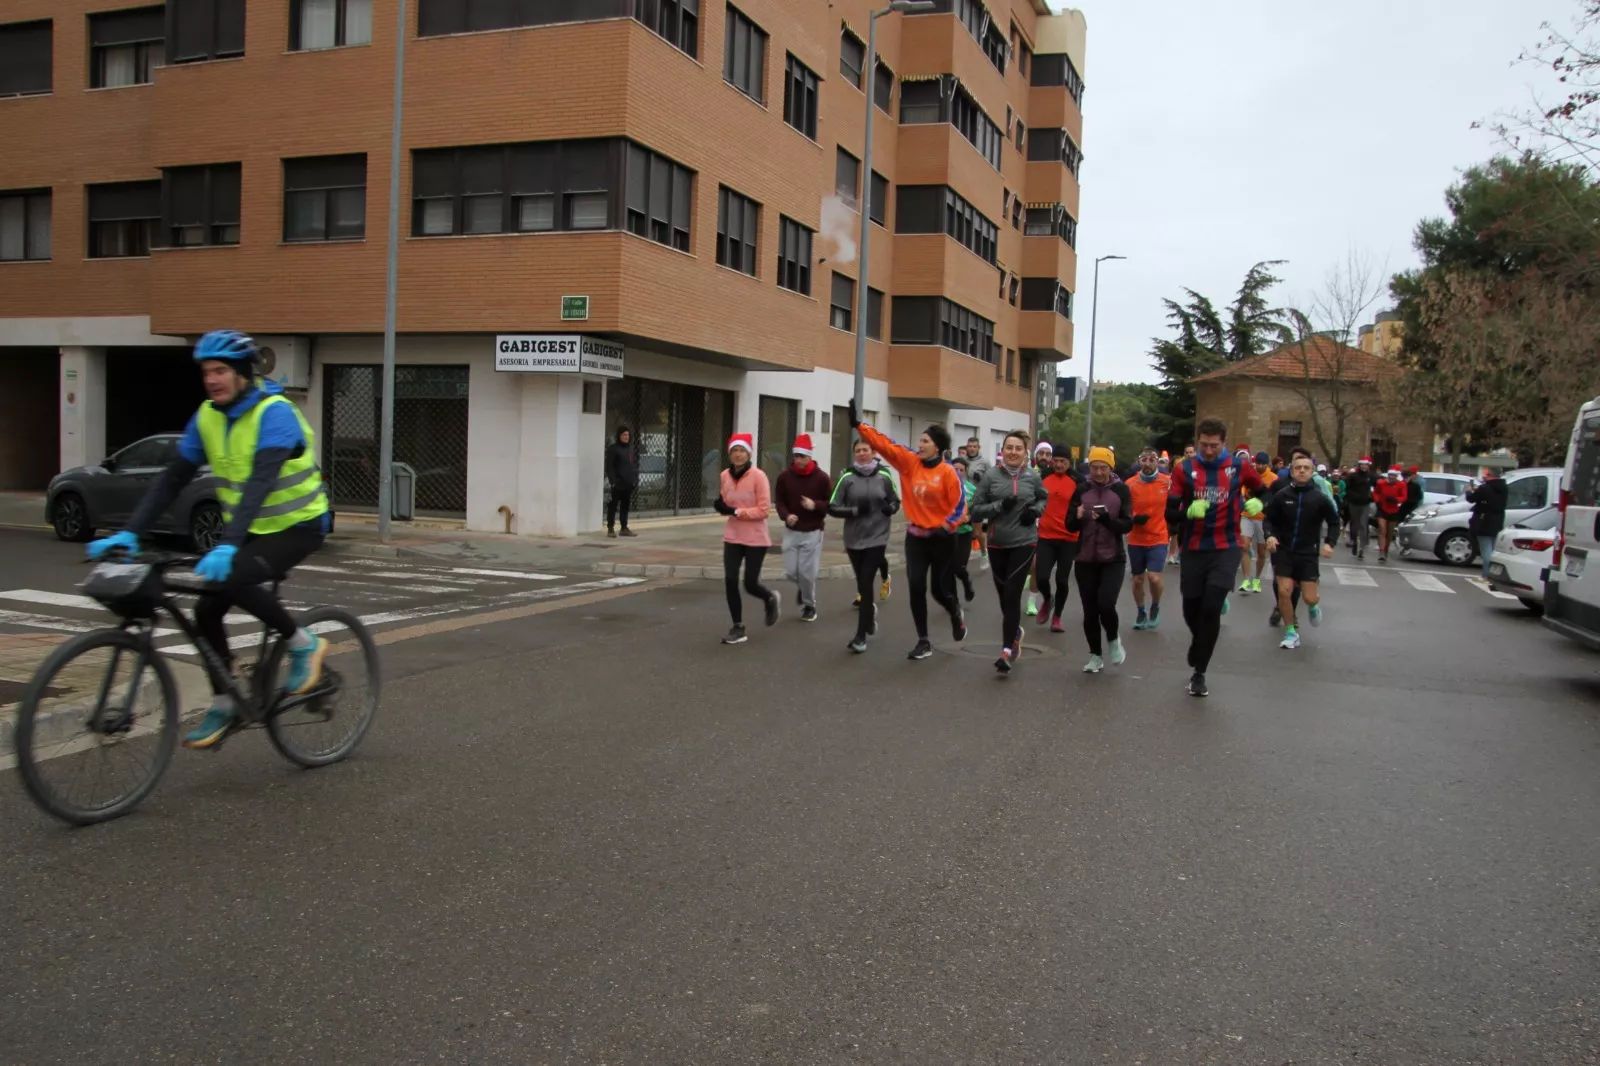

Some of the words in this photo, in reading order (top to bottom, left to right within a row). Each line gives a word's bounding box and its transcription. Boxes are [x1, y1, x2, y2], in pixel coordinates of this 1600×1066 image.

[500, 340, 576, 353] GABIGEST
[582, 342, 624, 360] GABIGEST
[532, 358, 577, 366] EMPRESARIAL
[582, 360, 598, 368] ASESORIA
[600, 362, 622, 372] EMPRESARIAL
